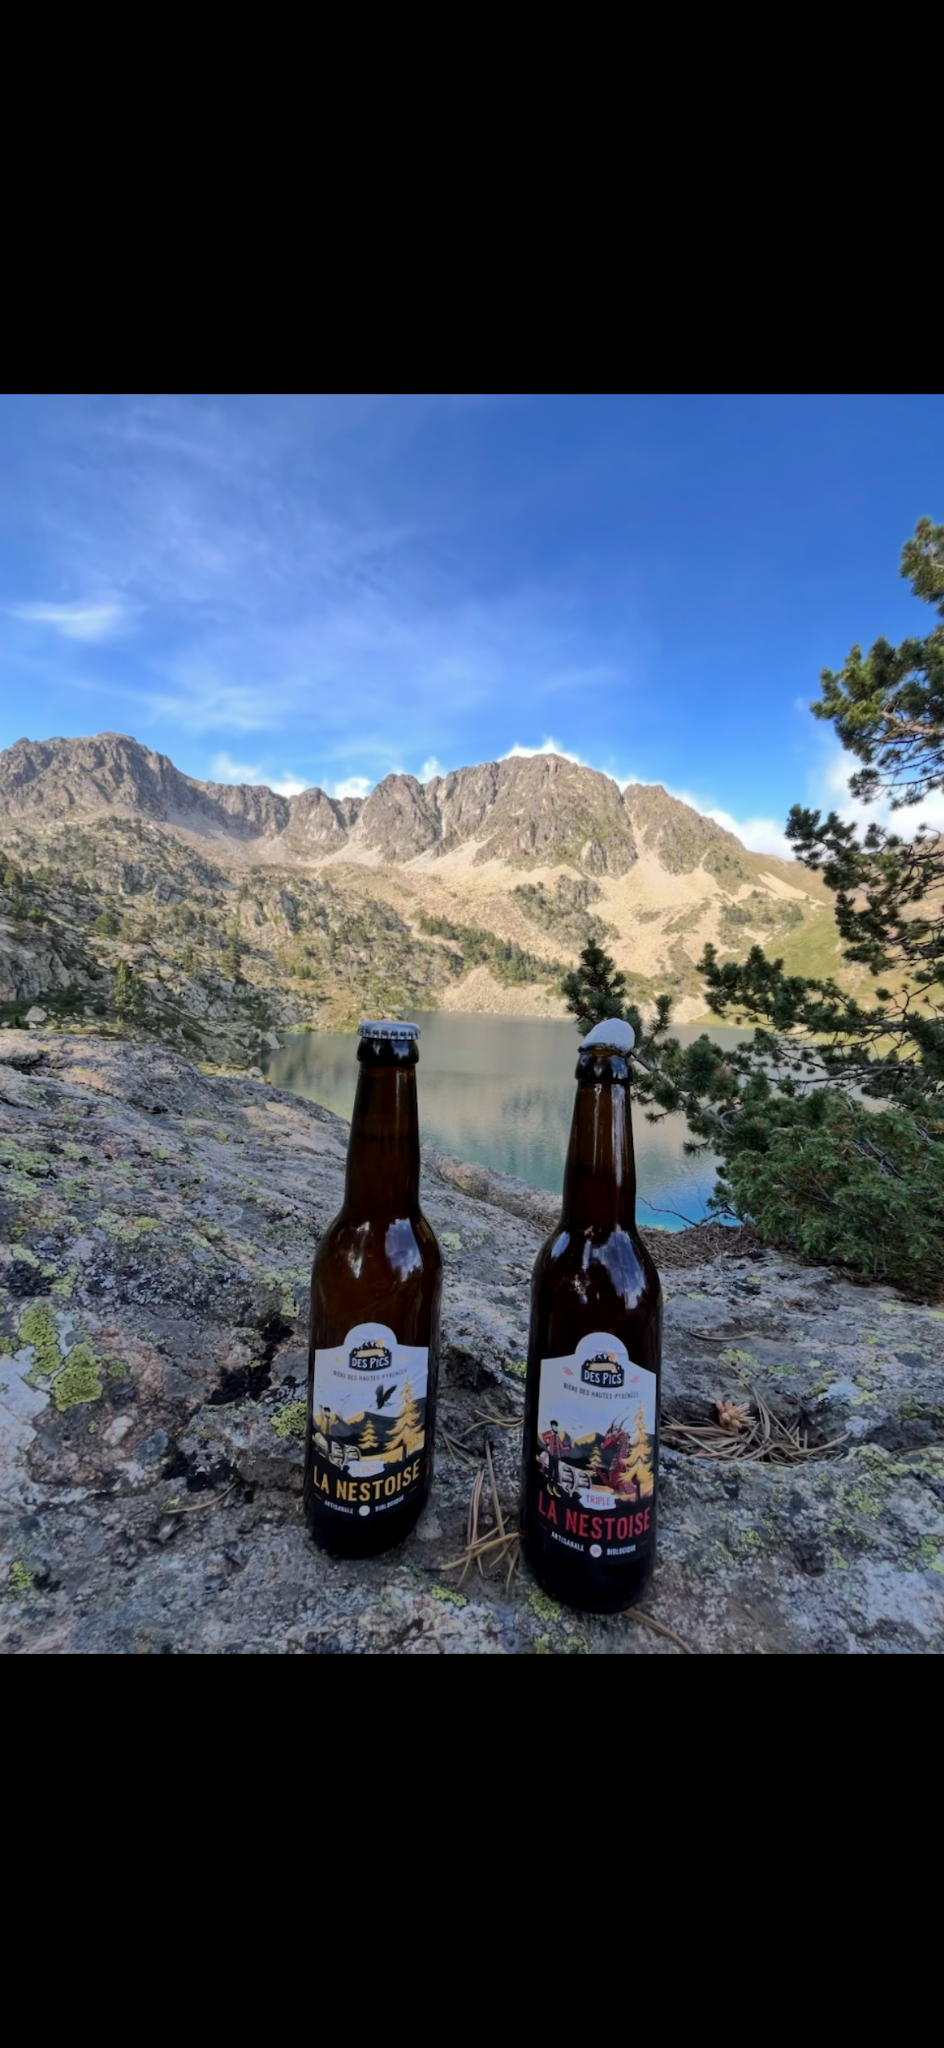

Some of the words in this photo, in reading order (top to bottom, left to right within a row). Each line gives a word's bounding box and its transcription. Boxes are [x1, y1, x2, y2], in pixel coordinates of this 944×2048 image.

[352, 1357, 368, 1368] DES
[584, 1370, 600, 1383] DES
[579, 1387, 590, 1396] DES
[314, 1465, 330, 1494] LA
[336, 1459, 420, 1501] NESTOISE
[586, 1494, 611, 1506] TRIPLE
[324, 1500, 354, 1514] ARTISANALE
[538, 1490, 558, 1525] LA
[565, 1506, 651, 1540] NESTOISE
[551, 1531, 585, 1552] ARTISANALE
[607, 1544, 637, 1556] BIOLOGIQUE
